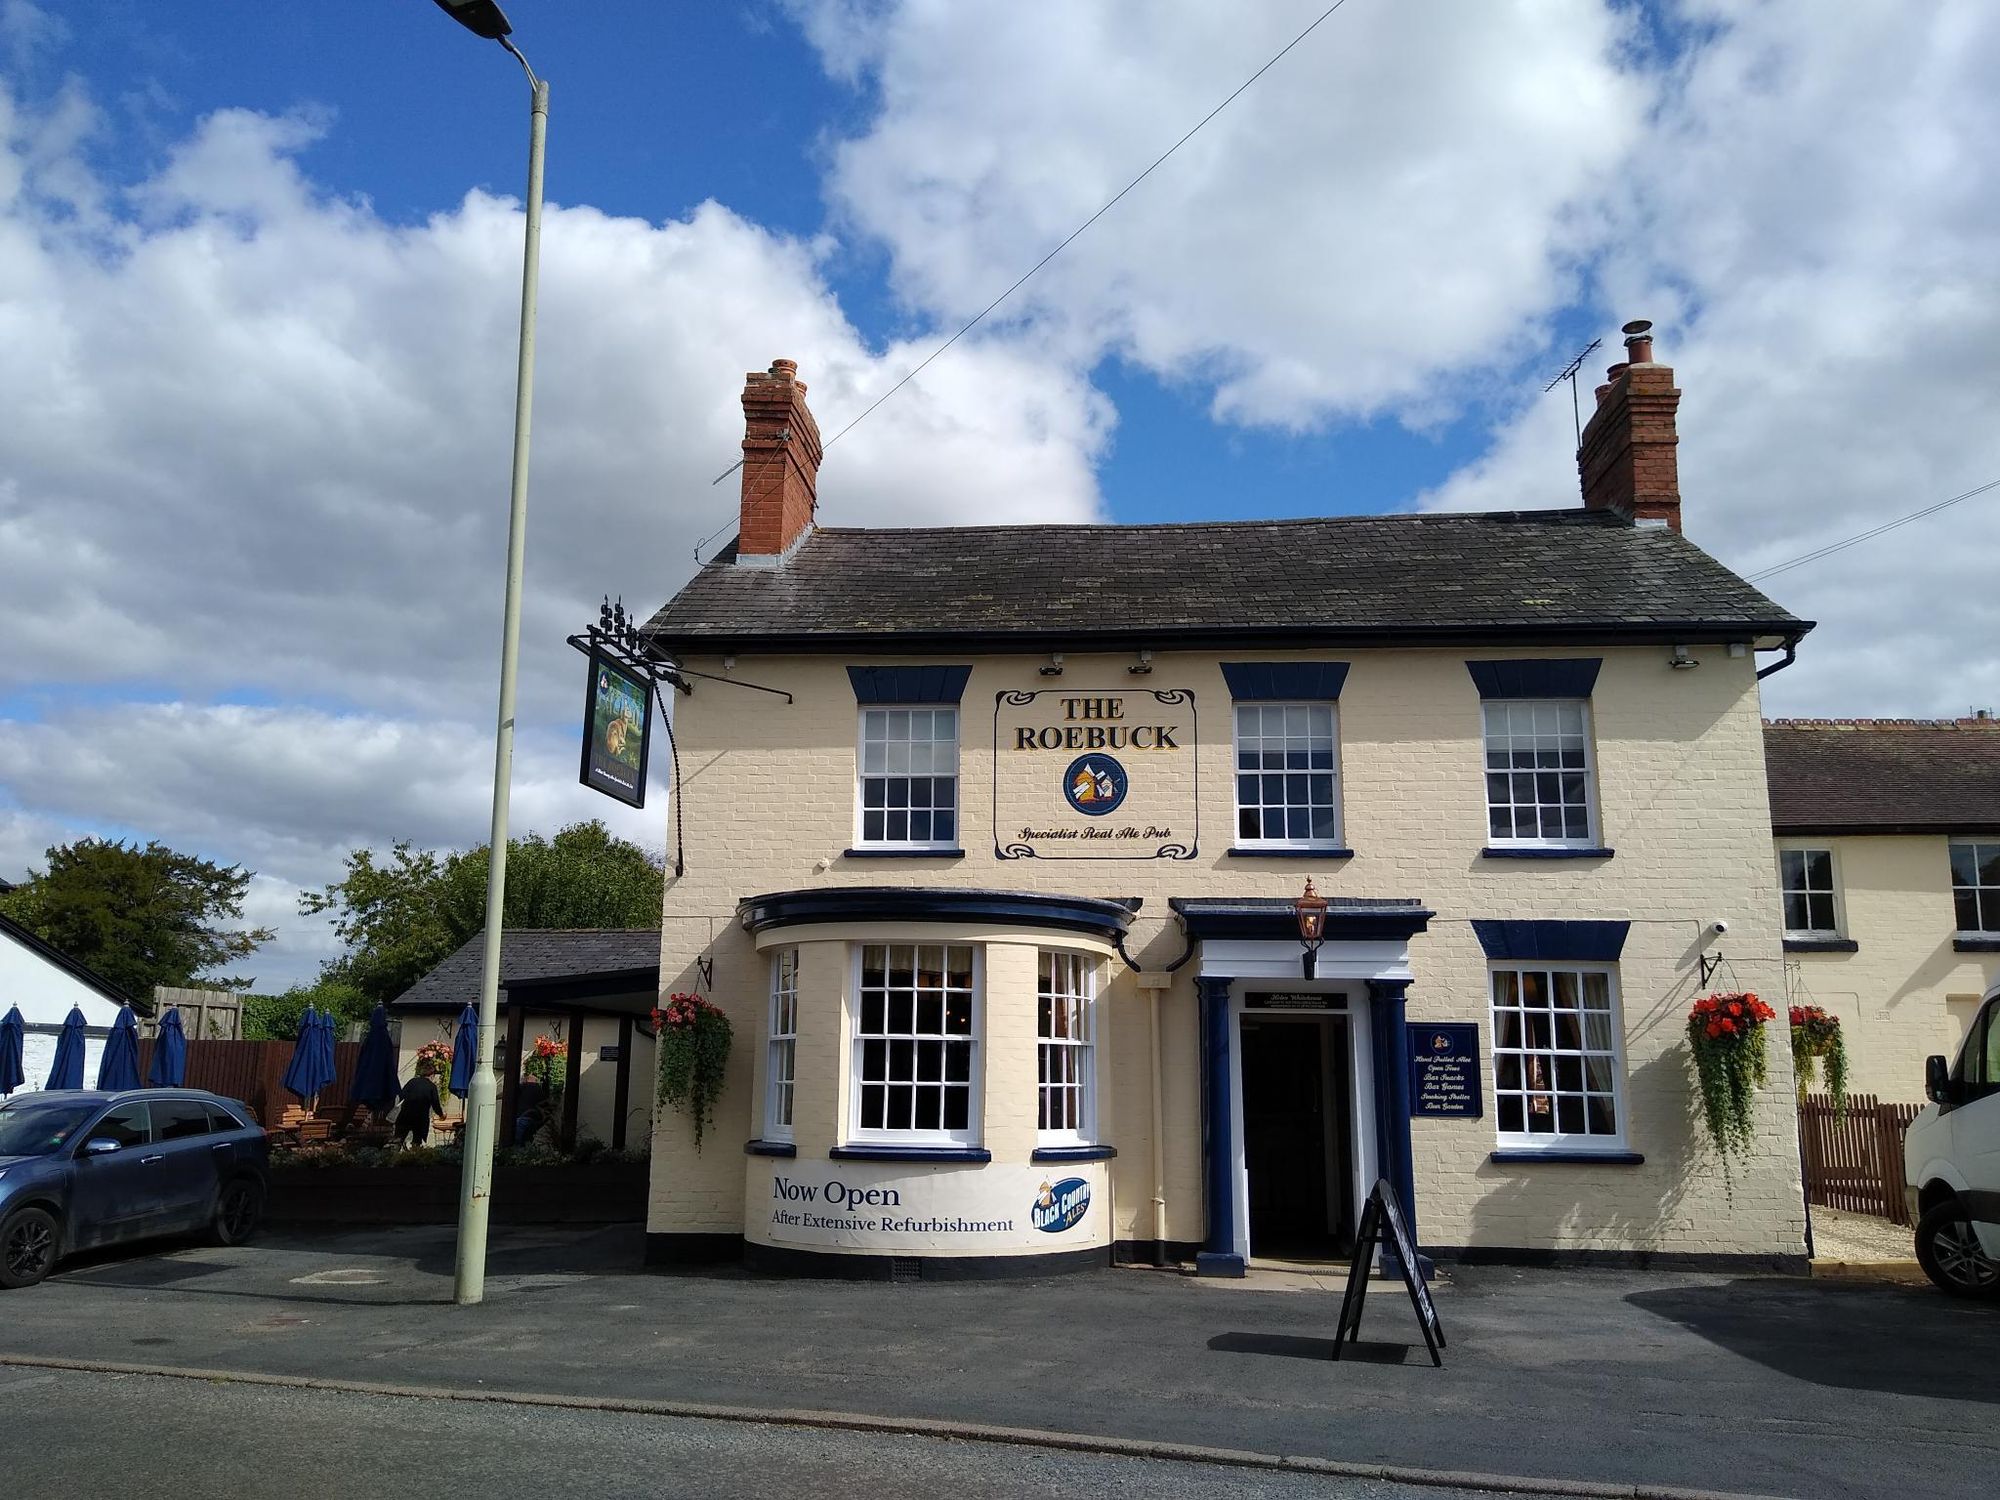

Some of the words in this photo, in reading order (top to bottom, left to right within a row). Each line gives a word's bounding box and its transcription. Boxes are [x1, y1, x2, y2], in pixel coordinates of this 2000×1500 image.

[1060, 698, 1125, 721] THE
[1013, 726, 1180, 751] ROEBUCK
[1018, 826, 1078, 842] Specialist
[1081, 826, 1113, 839] Real
[1115, 826, 1140, 839] Ale
[1143, 826, 1172, 839] Pub
[1428, 1064, 1443, 1073] Open
[1424, 1082, 1439, 1090] Bar
[1441, 1082, 1464, 1090] Games
[1421, 1092, 1447, 1102] Smoking
[1442, 1102, 1464, 1110] Garden
[773, 1176, 818, 1201] Now
[824, 1181, 901, 1211] Open
[771, 1209, 800, 1226] After
[803, 1212, 876, 1231] Extensive
[881, 1217, 1013, 1233] Refurbishment
